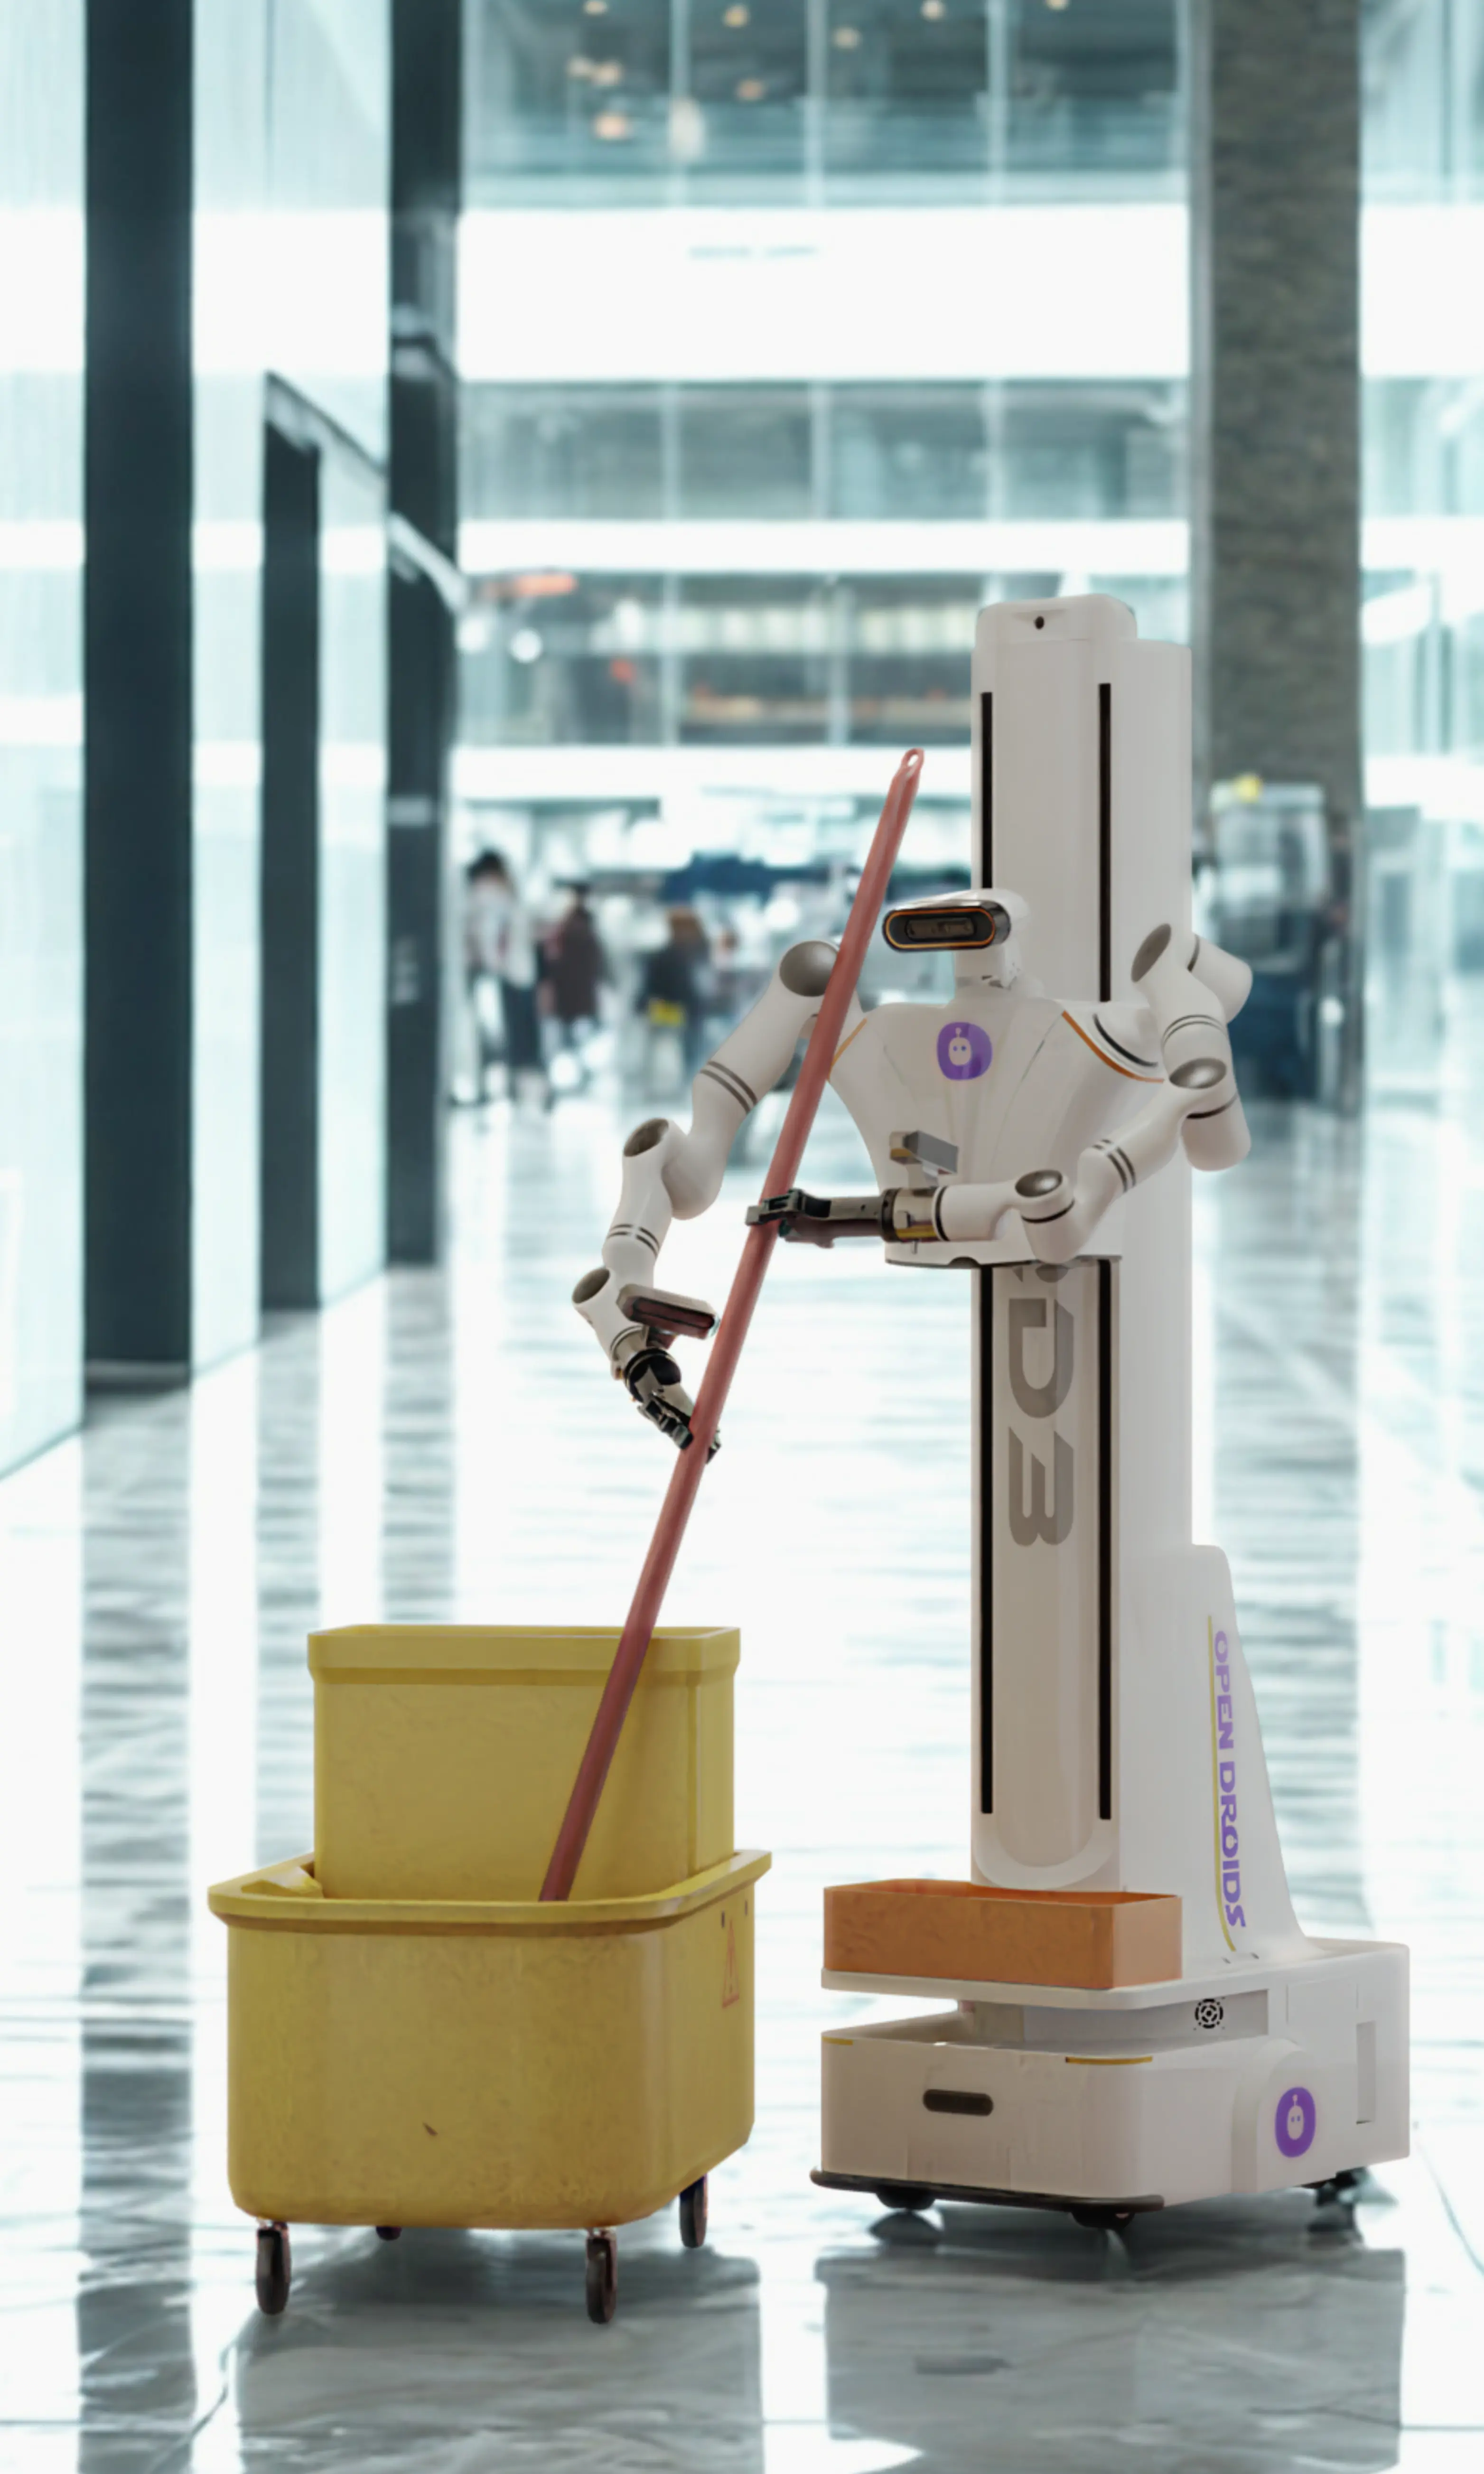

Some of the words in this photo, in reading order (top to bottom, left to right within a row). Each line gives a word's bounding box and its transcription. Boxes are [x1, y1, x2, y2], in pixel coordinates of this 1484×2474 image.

[1009, 1266, 1073, 1547] D3
[1214, 1631, 1234, 1750] OPEN
[1219, 1761, 1246, 1927] DROIDS
